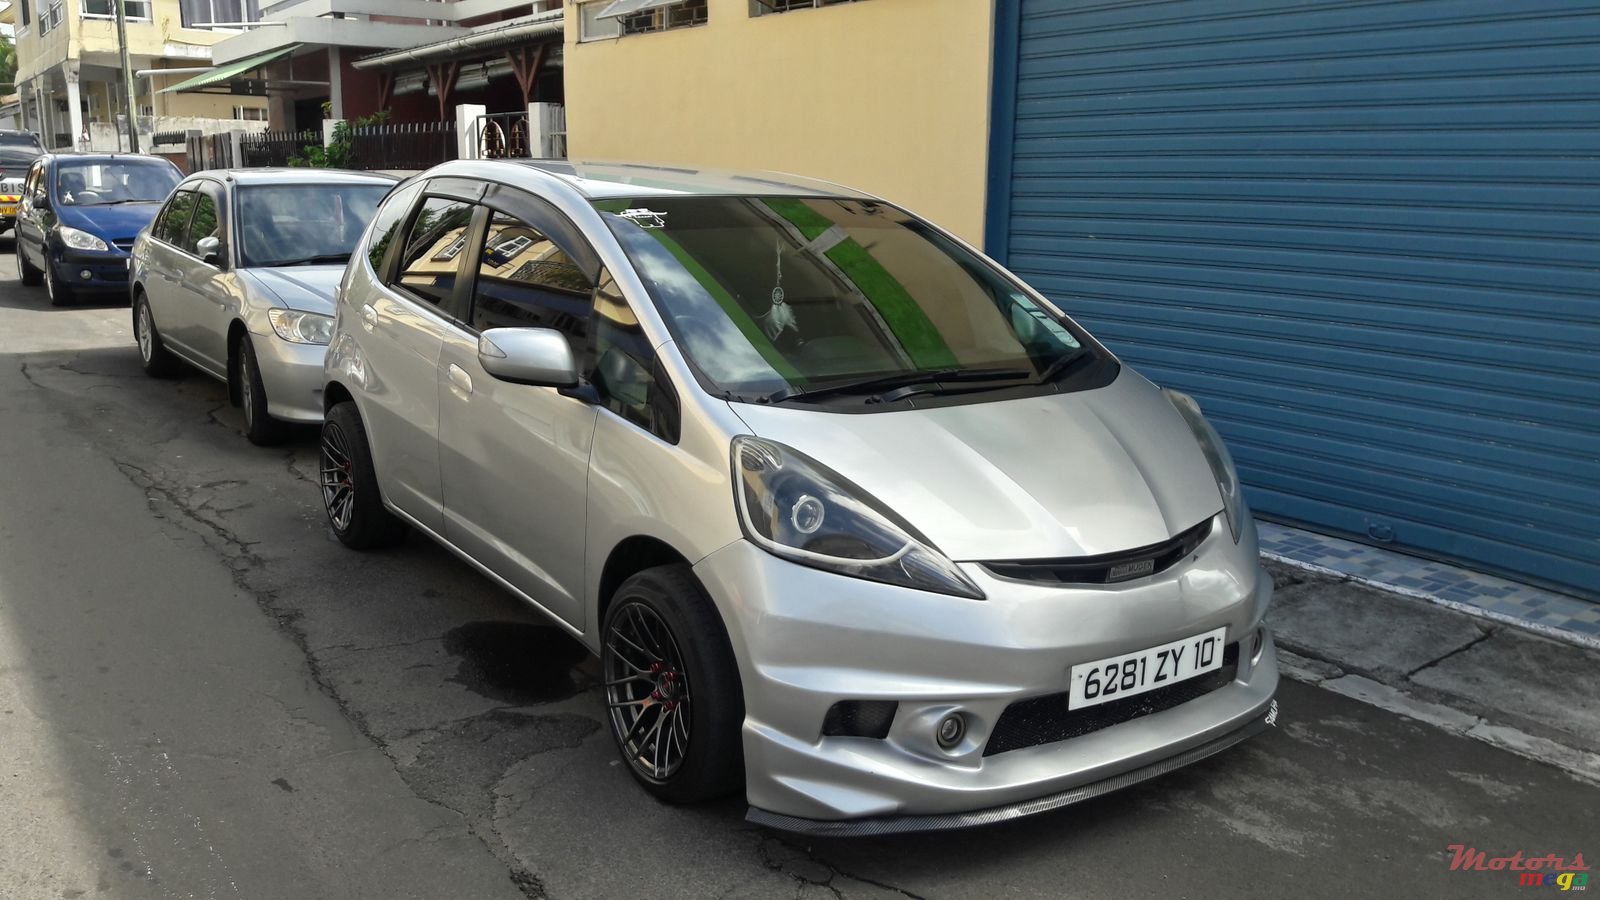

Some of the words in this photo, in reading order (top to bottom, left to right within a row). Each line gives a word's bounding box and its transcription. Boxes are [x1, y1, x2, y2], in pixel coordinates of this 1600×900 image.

[1084, 656, 1147, 700] 6281
[1154, 646, 1185, 683] ZY
[1194, 636, 1215, 670] 10
